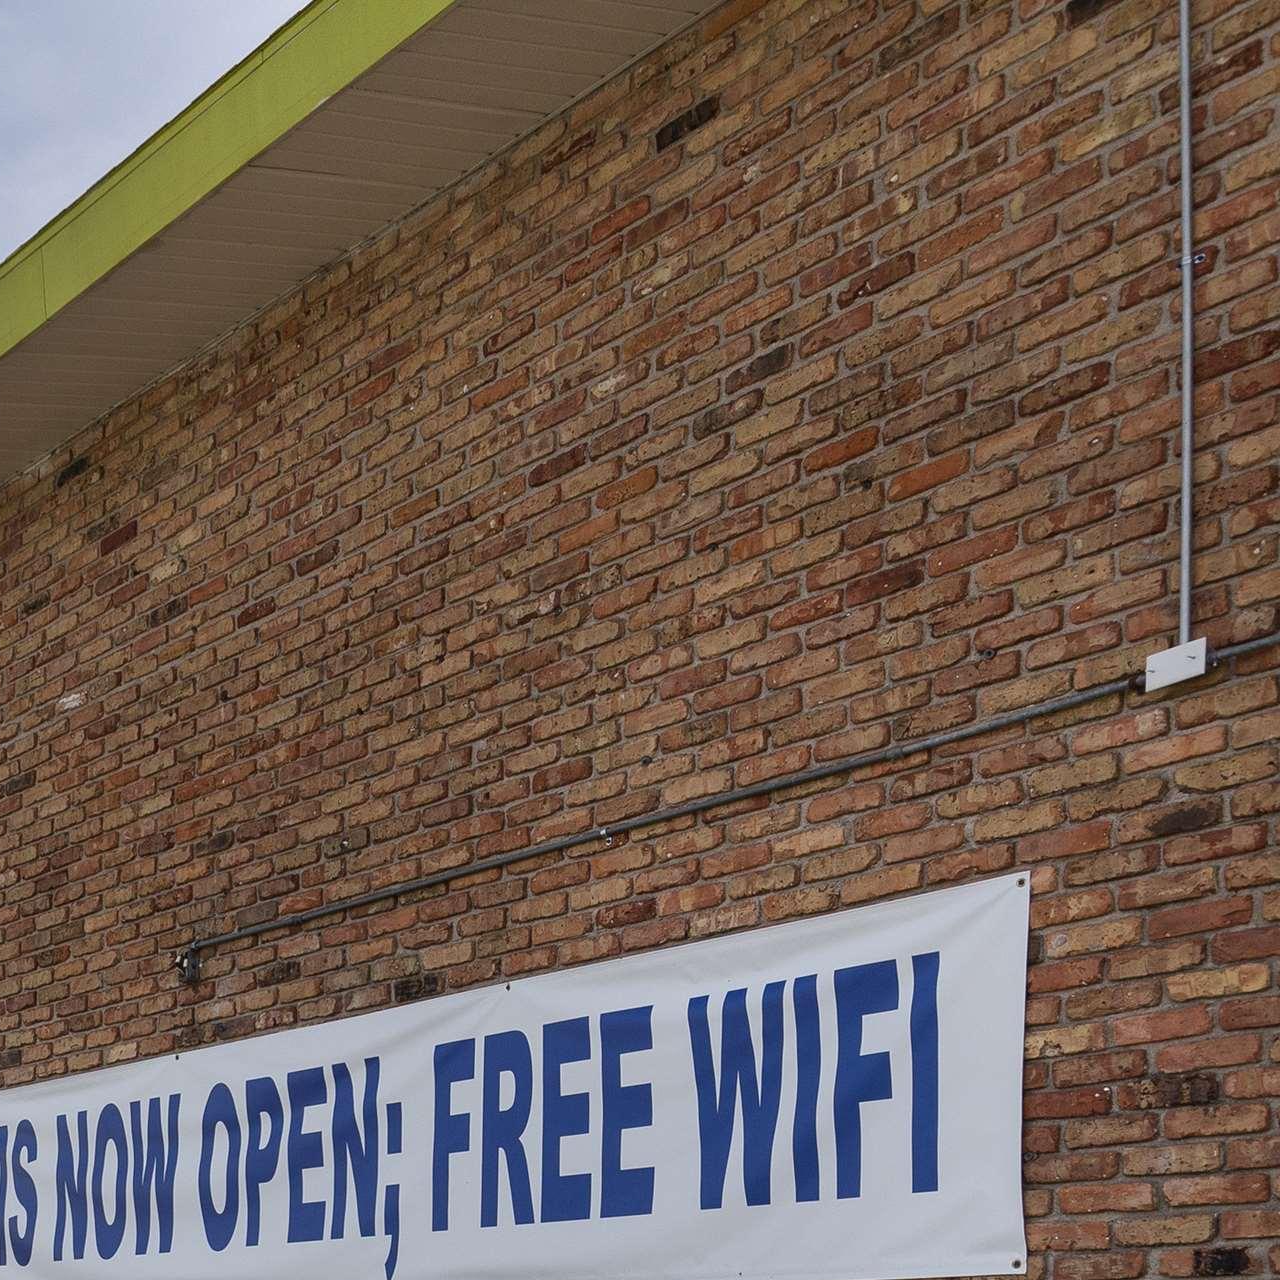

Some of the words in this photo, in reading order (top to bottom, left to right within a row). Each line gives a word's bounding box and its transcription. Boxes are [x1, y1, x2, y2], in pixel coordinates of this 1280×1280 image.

[53, 1093, 181, 1262] NOW
[432, 1005, 655, 1232] FREE
[687, 951, 940, 1210] WIFI
